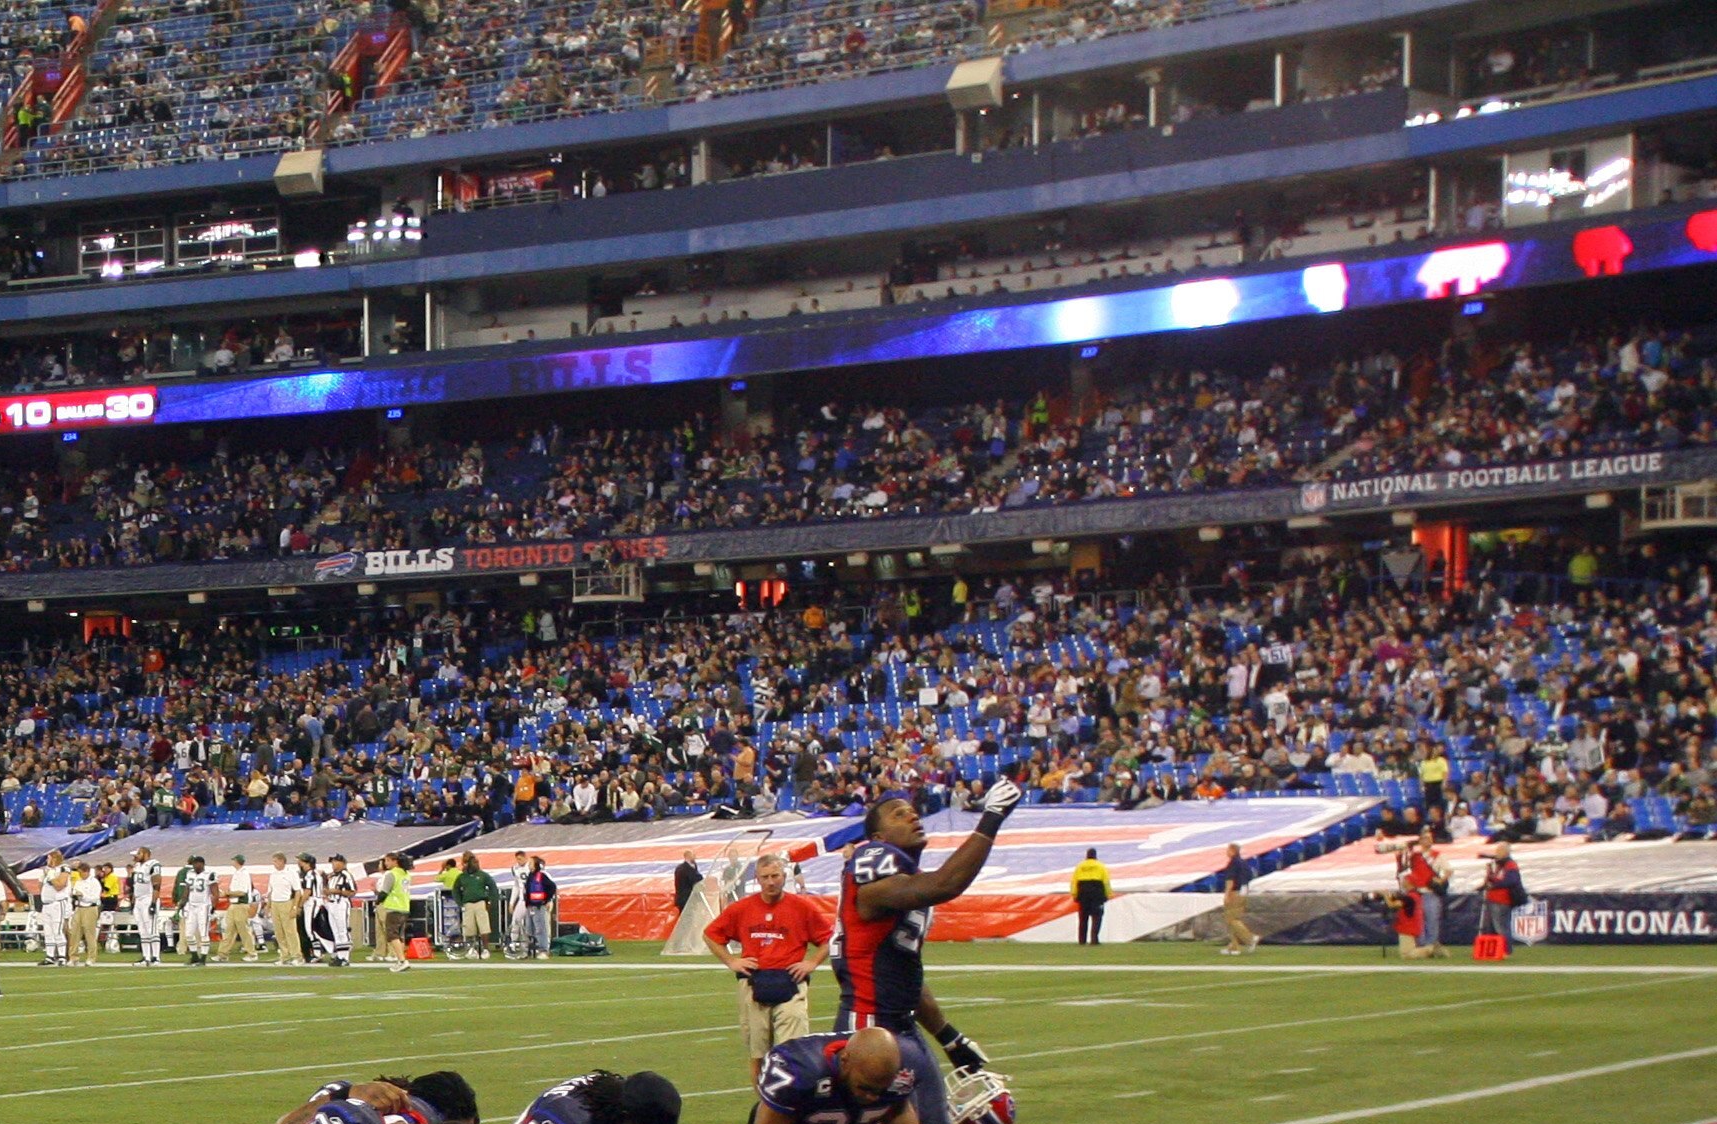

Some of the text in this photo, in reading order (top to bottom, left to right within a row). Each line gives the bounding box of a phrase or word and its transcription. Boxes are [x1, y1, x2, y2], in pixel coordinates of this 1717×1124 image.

[5, 401, 52, 427] 10
[105, 393, 154, 420] 30
[1332, 473, 1437, 502] NATIONAL
[1447, 461, 1562, 490] FOOTBALL
[1570, 452, 1663, 479] LEAGUE
[365, 547, 455, 576] BILLS
[462, 543, 575, 570] TORONTO
[376, 780, 385, 794] 6
[853, 853, 899, 884] 54
[1514, 909, 1710, 937] NFL NATIONAL
[1479, 939, 1498, 957] 10
